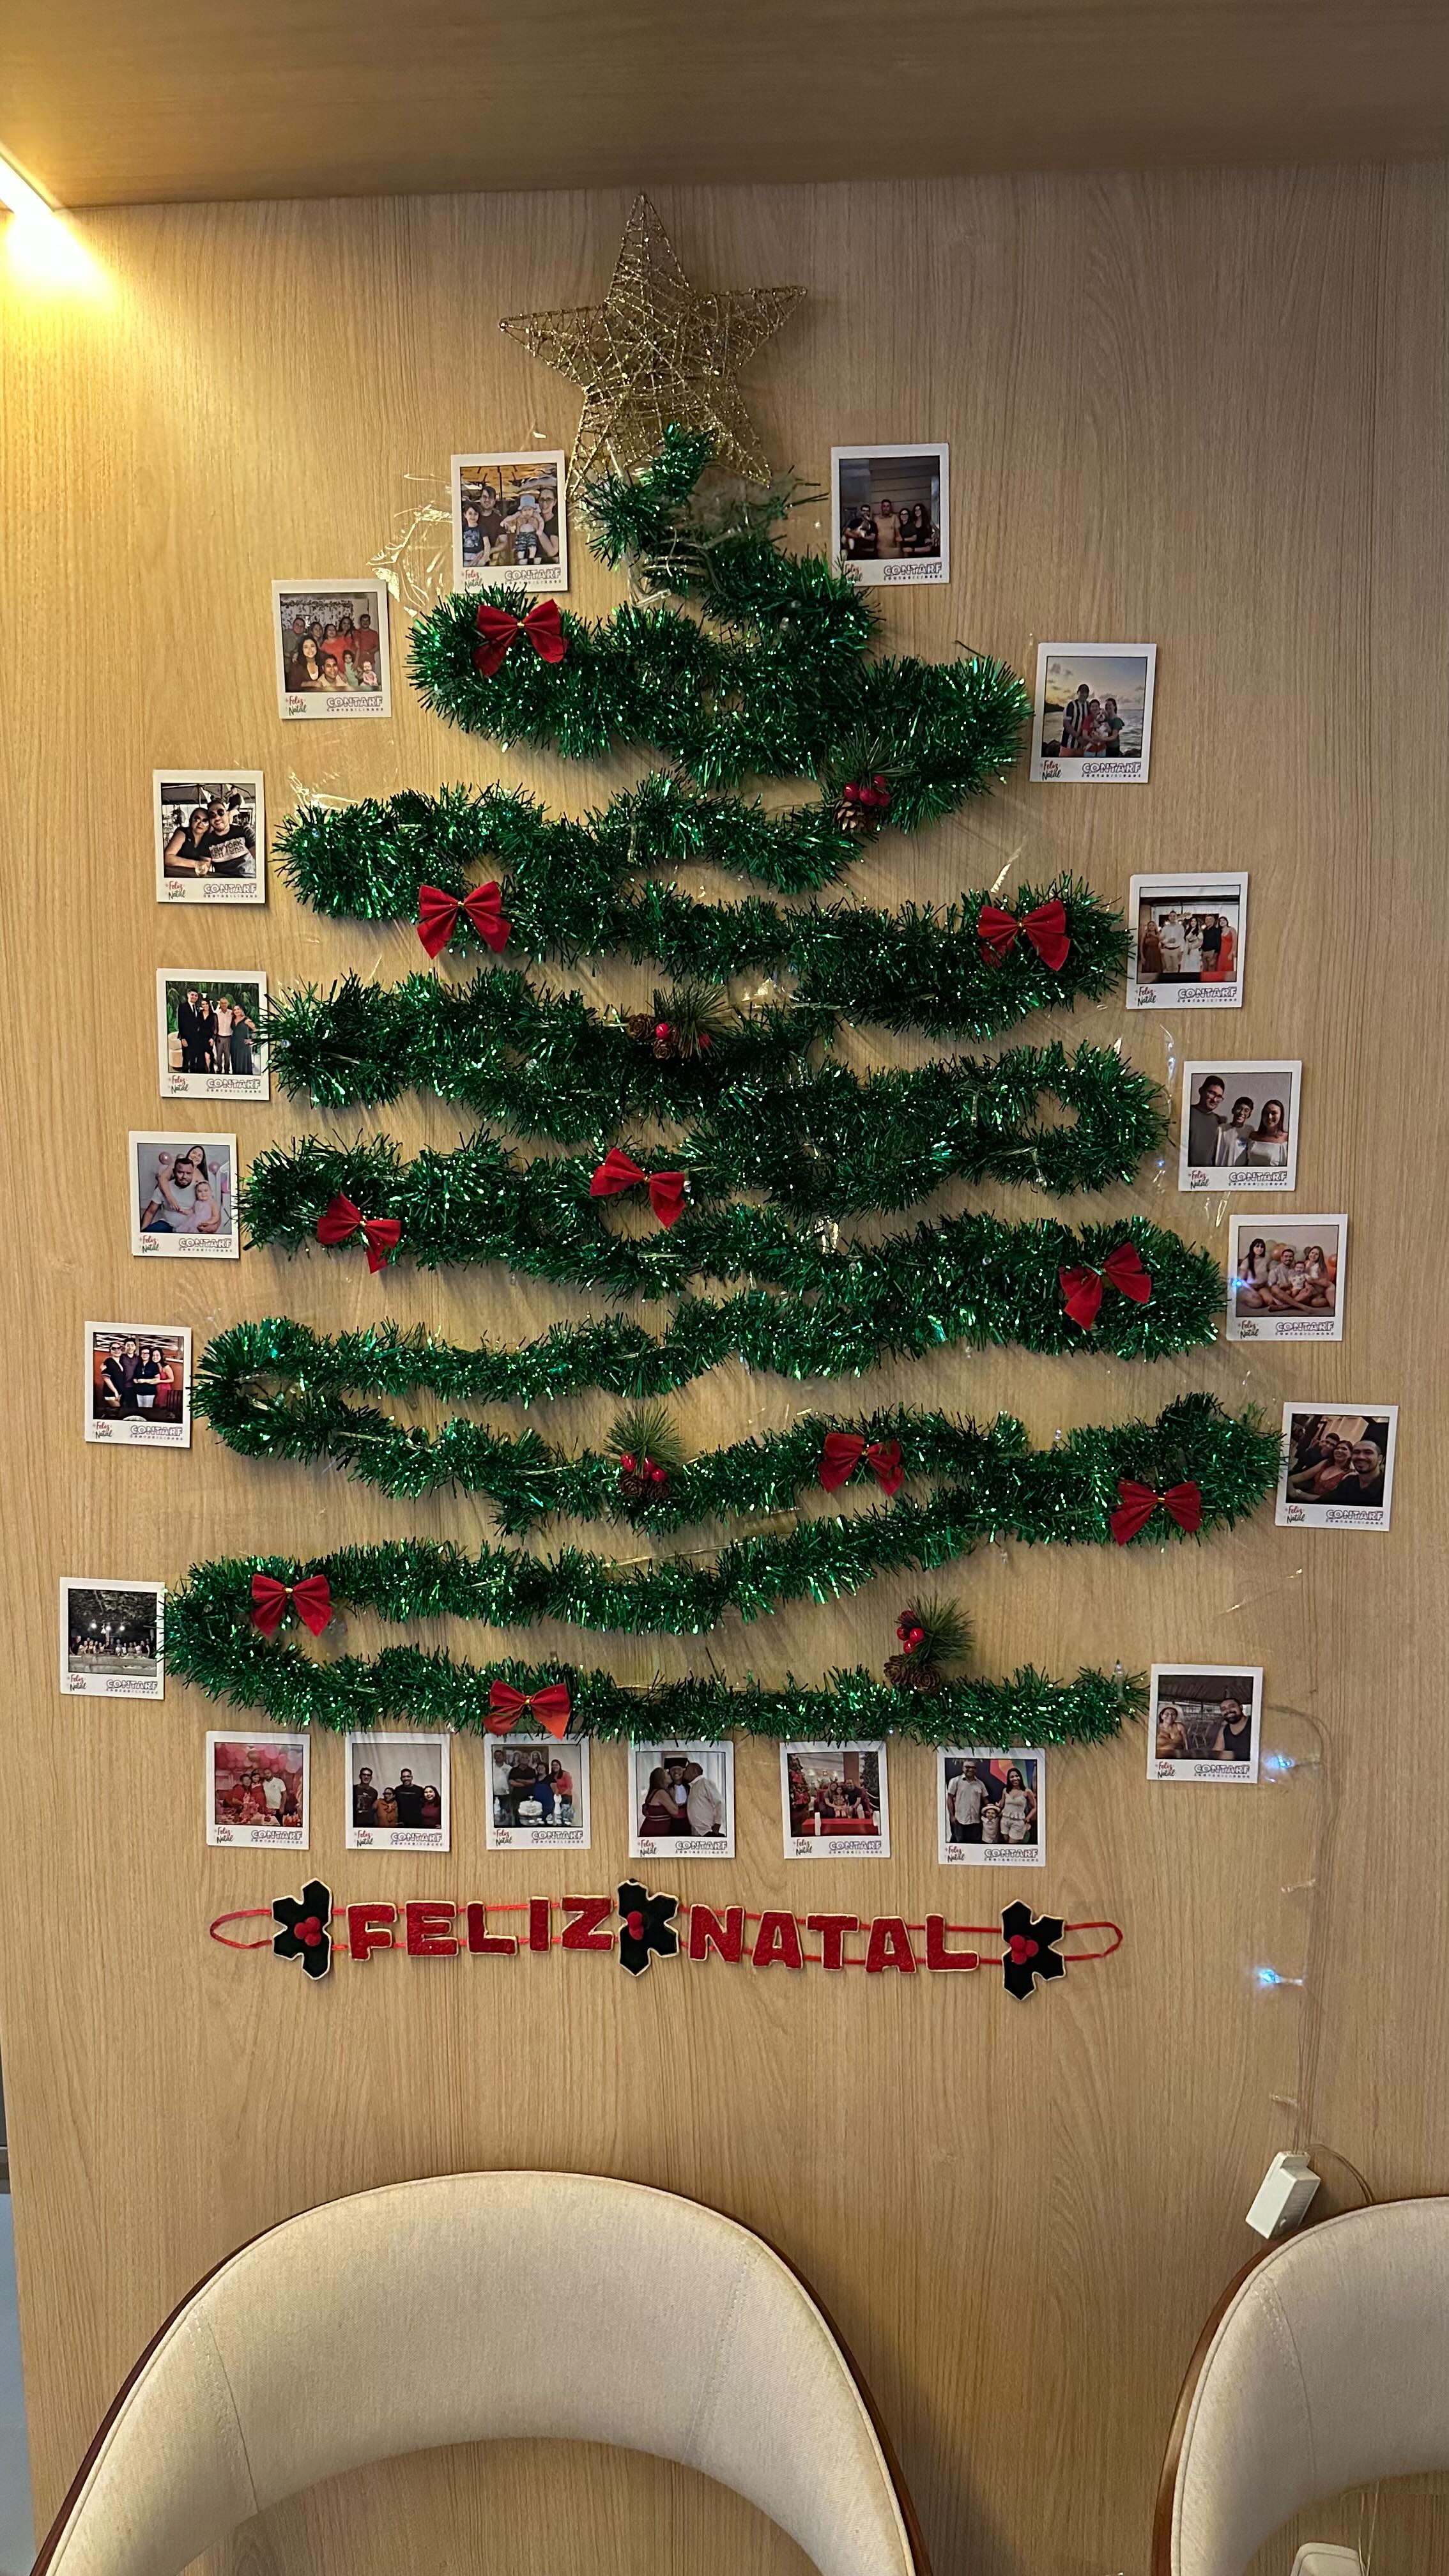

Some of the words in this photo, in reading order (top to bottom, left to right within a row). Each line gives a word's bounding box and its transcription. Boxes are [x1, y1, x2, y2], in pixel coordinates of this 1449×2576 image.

[465, 569, 480, 579] Feliz
[505, 567, 561, 580] CONTARF
[884, 562, 942, 576] CONTARF
[465, 578, 482, 589] Natal
[289, 696, 304, 706] Feliz
[327, 694, 383, 707] CONTARF
[289, 705, 307, 716] Natal
[1043, 760, 1059, 770] Feliz
[1082, 762, 1142, 774] CONTARF
[1042, 769, 1061, 781] Natal
[169, 881, 183, 891] Feliz
[204, 883, 257, 894] CONTARF
[169, 889, 185, 900] Natal
[1138, 986, 1154, 997] Feliz
[1178, 986, 1237, 999] CONTARF
[1137, 995, 1156, 1006] Natal
[172, 1076, 186, 1085] Feliz
[206, 1079, 261, 1089] CONTARF
[171, 1084, 188, 1093] Natal
[1192, 1170, 1206, 1180] Feliz
[1229, 1171, 1287, 1181] CONTARF
[1191, 1178, 1208, 1189] Natal
[142, 1235, 157, 1245] Feliz
[179, 1238, 231, 1248] CONTARF
[142, 1243, 159, 1253] Natal
[1241, 1320, 1257, 1330] Feliz
[1275, 1322, 1334, 1332] CONTARF
[1241, 1328, 1258, 1338] Natal
[96, 1422, 110, 1432] Feliz
[130, 1425, 183, 1437] CONTARF
[95, 1429, 112, 1439] Natal
[1288, 1505, 1303, 1515] Feliz
[1326, 1509, 1383, 1521] CONTARF
[1287, 1513, 1305, 1523] Natal
[71, 1675, 84, 1683] Feliz
[70, 1682, 86, 1691] Natal
[106, 1680, 158, 1690] CONTARF
[1158, 1761, 1172, 1771] Feliz
[1194, 1764, 1250, 1774] CONTARF
[1158, 1768, 1175, 1778] Natal
[218, 1827, 231, 1837] Feliz
[251, 1830, 302, 1840] CONTARF
[358, 1830, 371, 1839] Feliz
[391, 1832, 442, 1842] CONTARF
[496, 1829, 510, 1839] Feliz
[532, 1831, 583, 1840] CONTARF
[217, 1834, 233, 1843] Natal
[356, 1837, 373, 1846] Natal
[496, 1836, 512, 1846] Natal
[641, 1839, 654, 1848] Feliz
[796, 1839, 810, 1848] Feliz
[675, 1841, 727, 1850] CONTARF
[795, 1846, 812, 1855] Natal
[829, 1841, 882, 1850] CONTARF
[948, 1846, 962, 1855] Feliz
[640, 1846, 656, 1856] Natal
[985, 1849, 1038, 1858] CONTARF
[947, 1853, 965, 1862] Natal
[346, 1895, 616, 1961] FELIZ
[689, 1903, 980, 1972] NATAL
